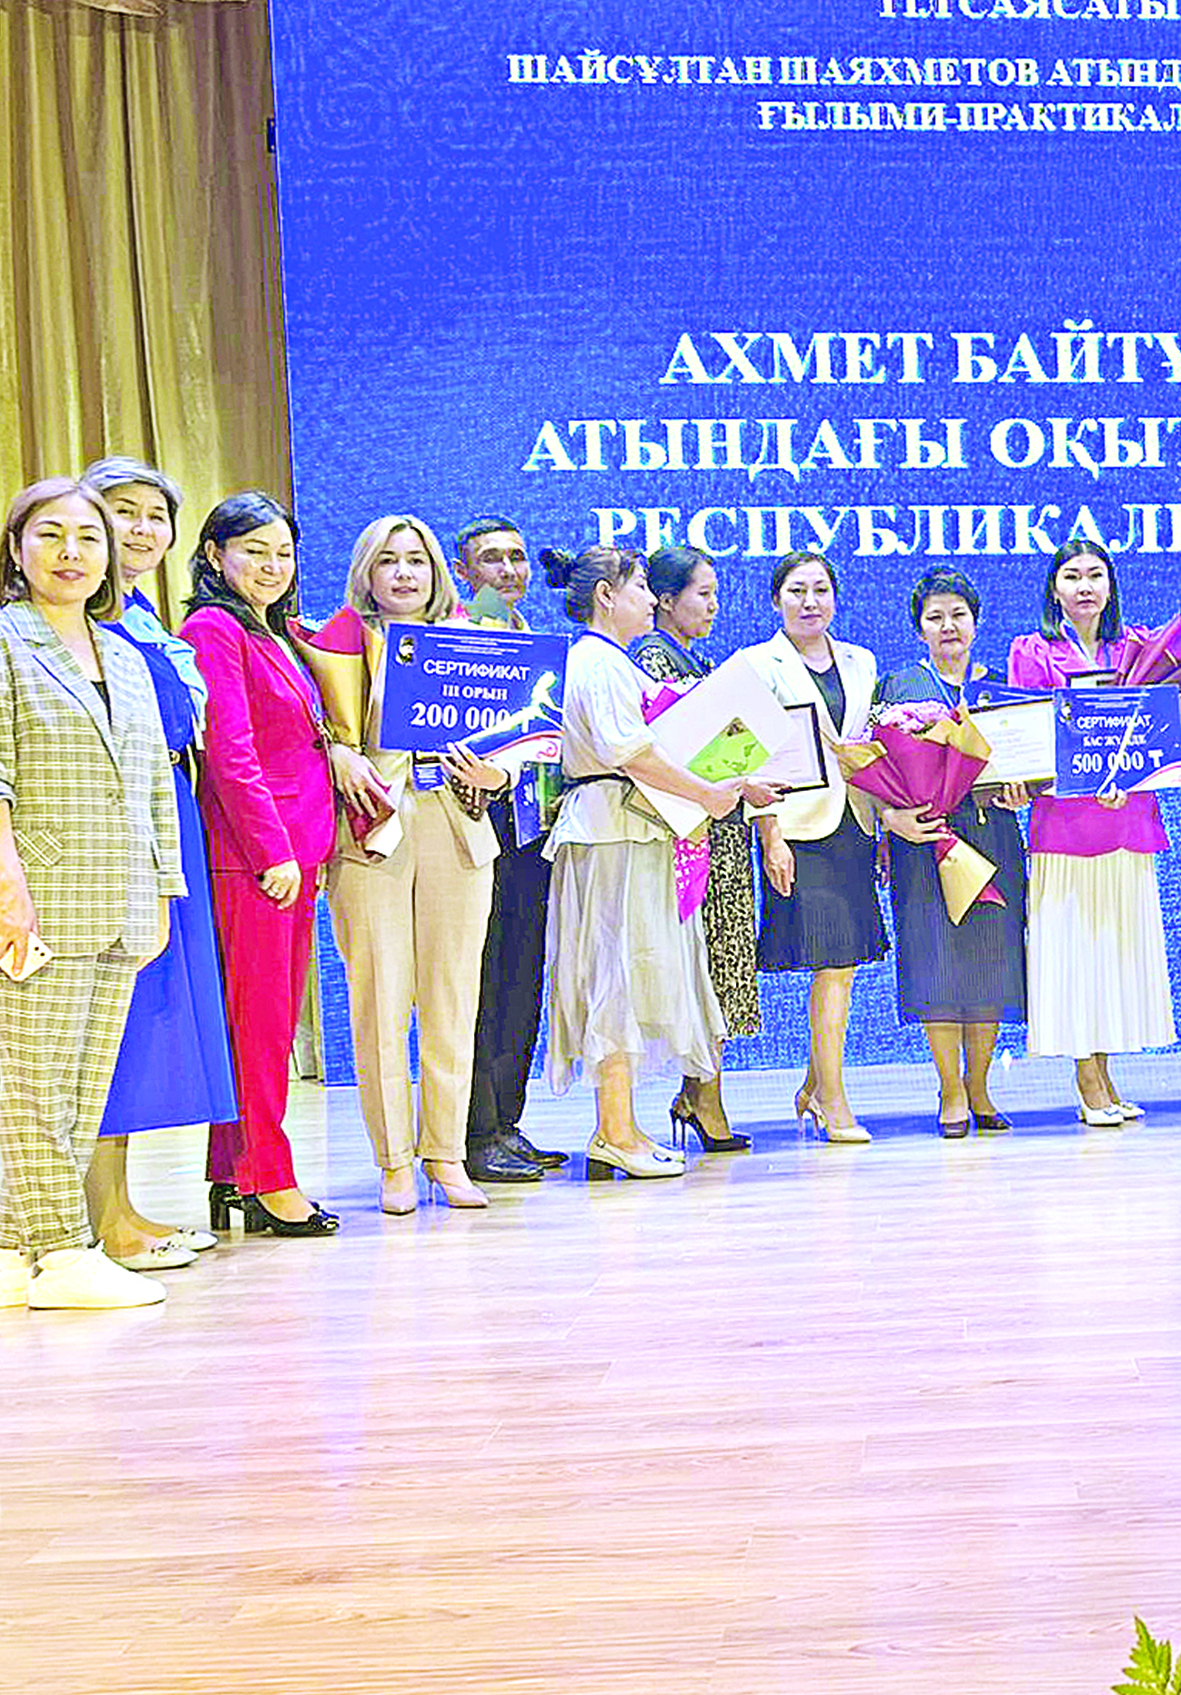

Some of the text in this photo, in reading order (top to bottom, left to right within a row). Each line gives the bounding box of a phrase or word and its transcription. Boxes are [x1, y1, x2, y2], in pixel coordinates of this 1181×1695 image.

[506, 48, 772, 84] ШАЙСҰЛТАН
[779, 56, 1039, 85] ШАЯХМЕТОВ
[658, 331, 933, 385] АХМЕТ
[520, 417, 968, 482] АТЫНДАҒЫ
[423, 659, 531, 681] СЕРТИФИКАТ
[462, 685, 508, 701] ОРЫН
[410, 702, 459, 729] 200
[1071, 753, 1103, 774] 500
[1107, 750, 1145, 772] 000
